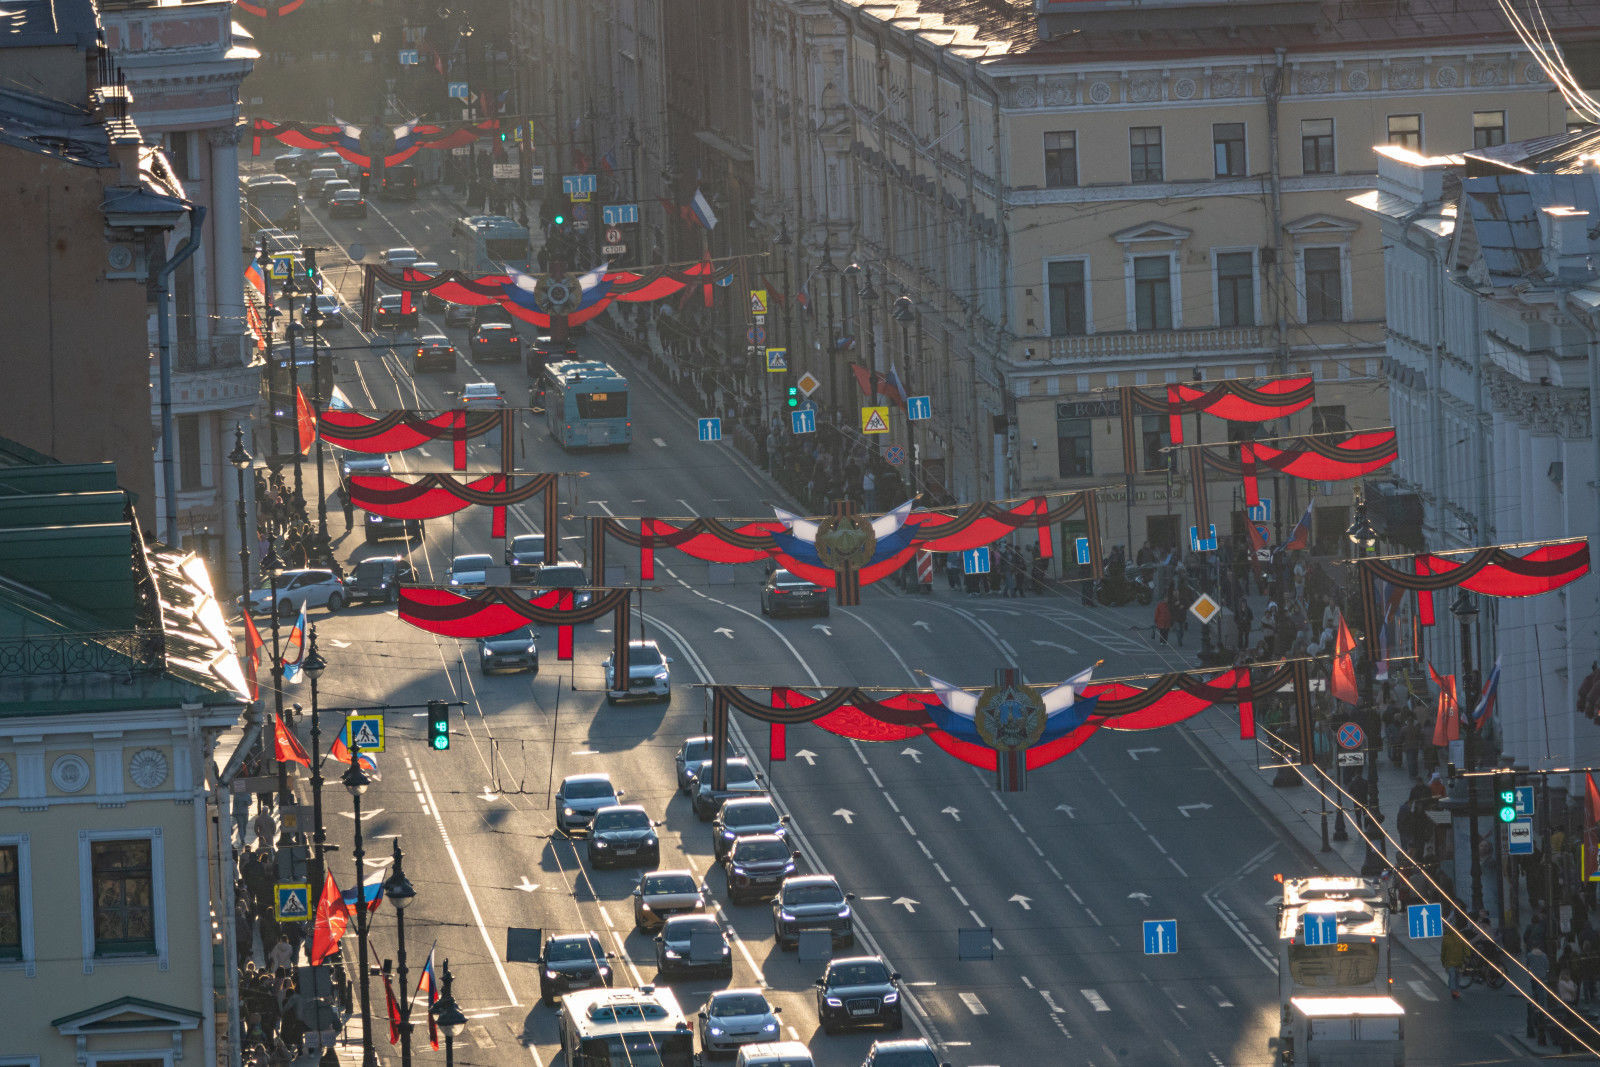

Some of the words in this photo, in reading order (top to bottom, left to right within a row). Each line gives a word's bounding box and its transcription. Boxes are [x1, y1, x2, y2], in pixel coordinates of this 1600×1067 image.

[435, 721, 447, 732] 48
[1501, 791, 1514, 803] 48
[1336, 943, 1349, 952] 22
